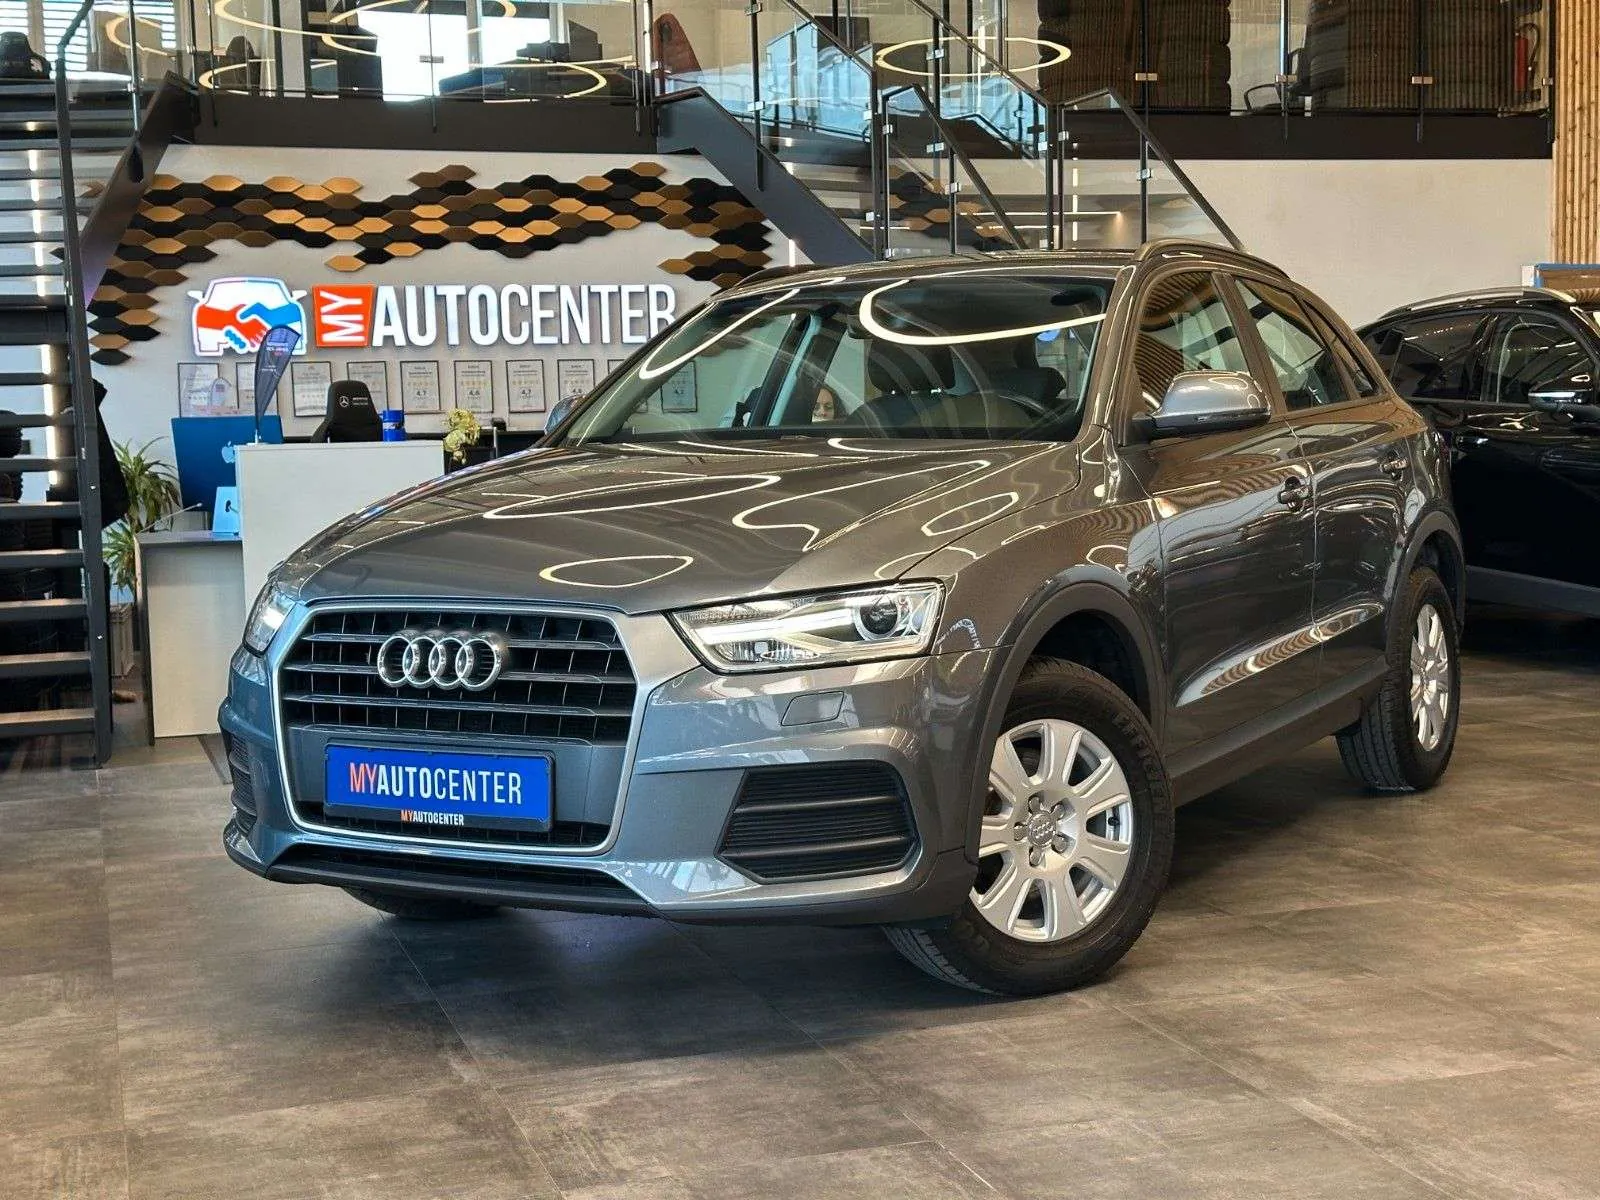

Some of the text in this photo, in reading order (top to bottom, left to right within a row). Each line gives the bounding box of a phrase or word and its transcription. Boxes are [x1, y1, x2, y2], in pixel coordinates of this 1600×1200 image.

[320, 284, 676, 347] MY AUTOCENTER
[350, 762, 522, 804] MYAUTOCENTER
[400, 810, 464, 826] MYAUTOCENTER
